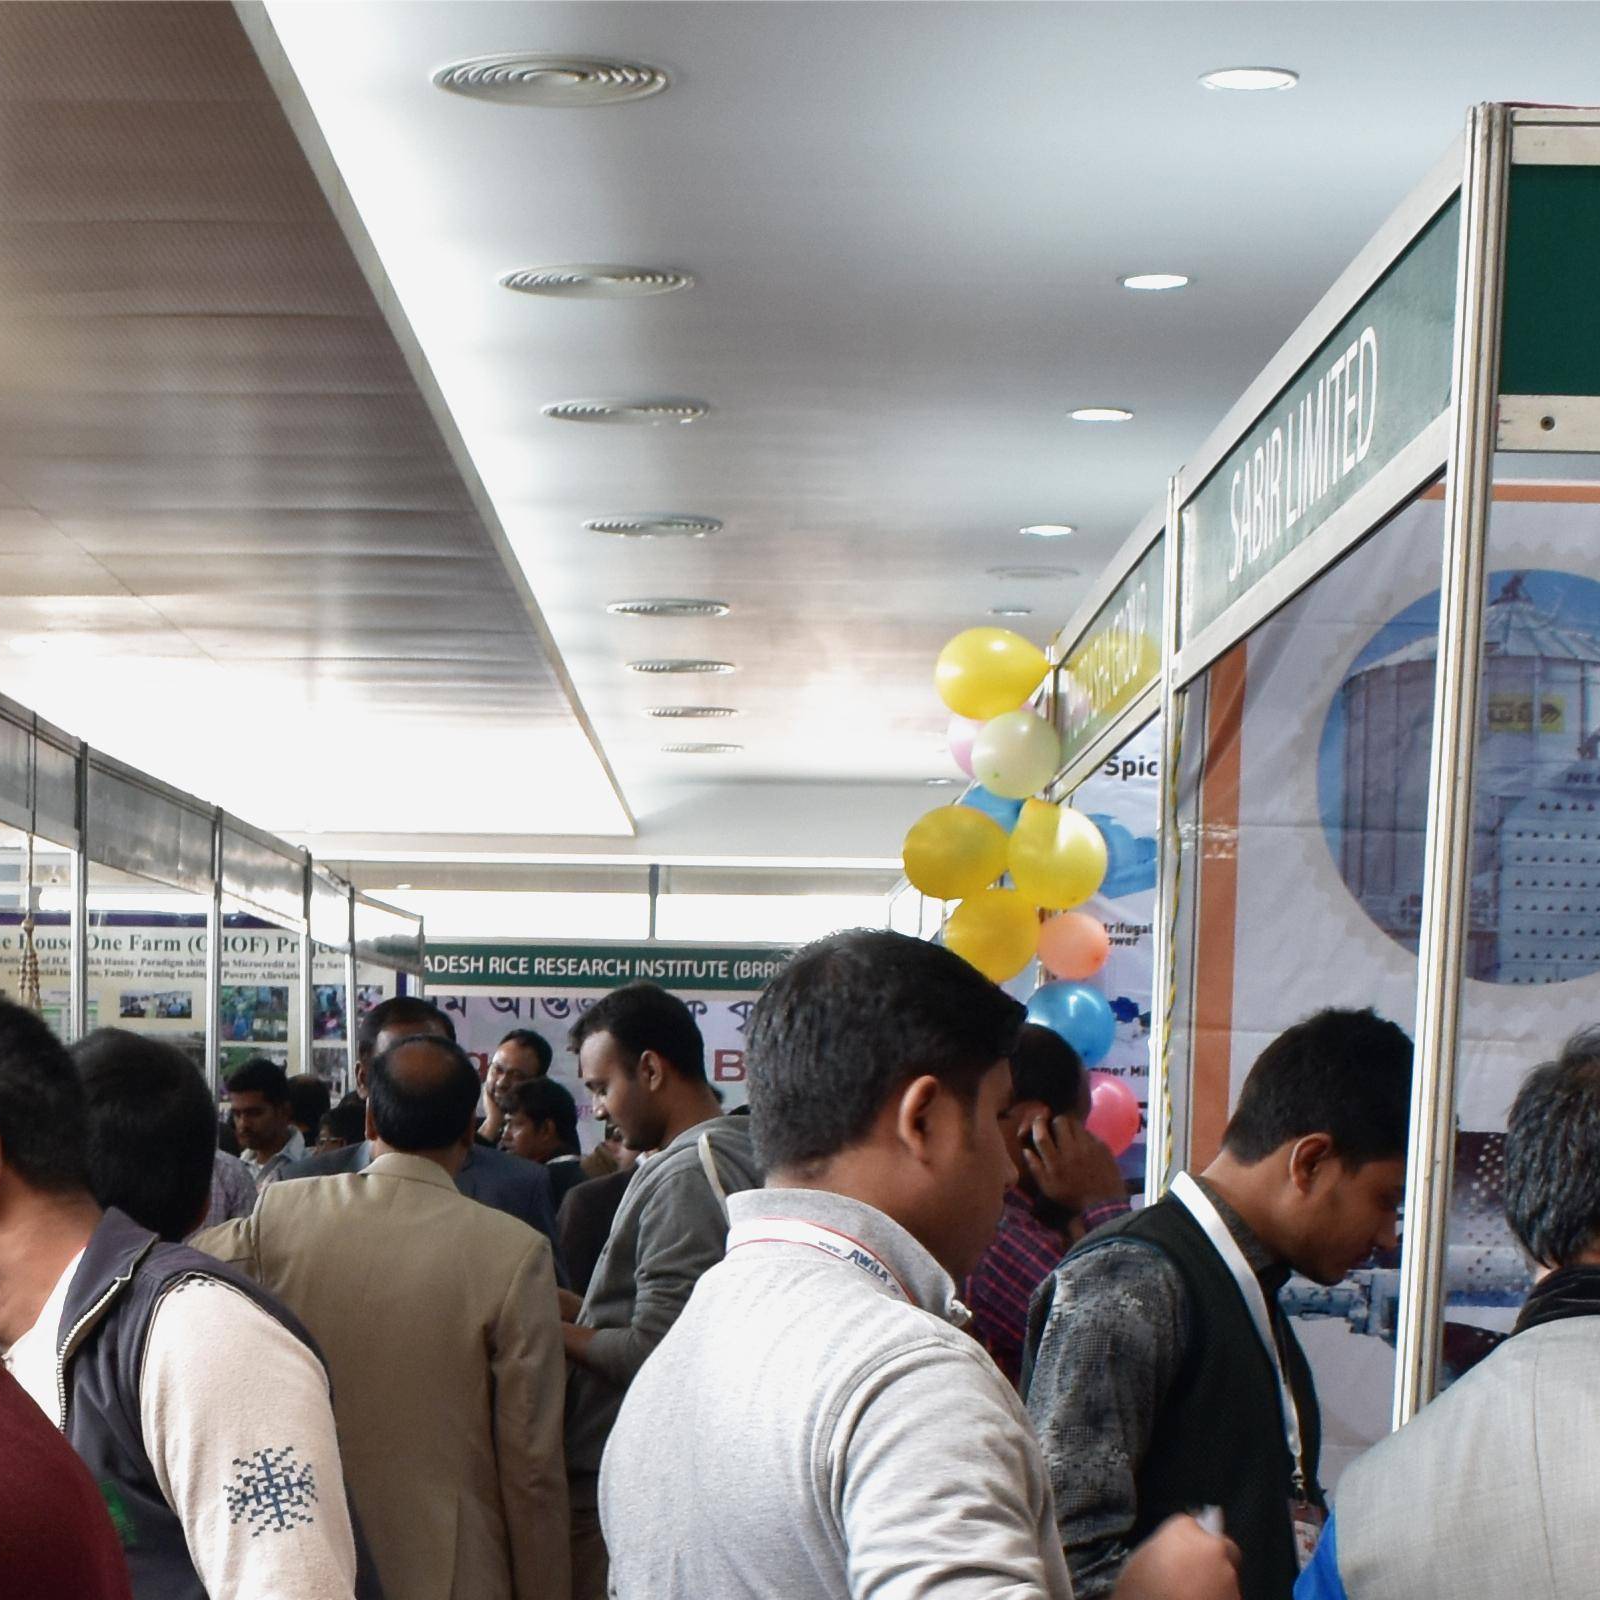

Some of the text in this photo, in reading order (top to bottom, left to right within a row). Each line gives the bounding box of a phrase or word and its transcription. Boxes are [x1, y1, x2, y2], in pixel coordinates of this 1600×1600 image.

[1228, 326, 1380, 583] SABIR LIMITED
[129, 935, 181, 951] Farm
[489, 956, 529, 974] RICE
[534, 957, 631, 976] RESEARCH
[635, 959, 729, 978] INSTITUTE
